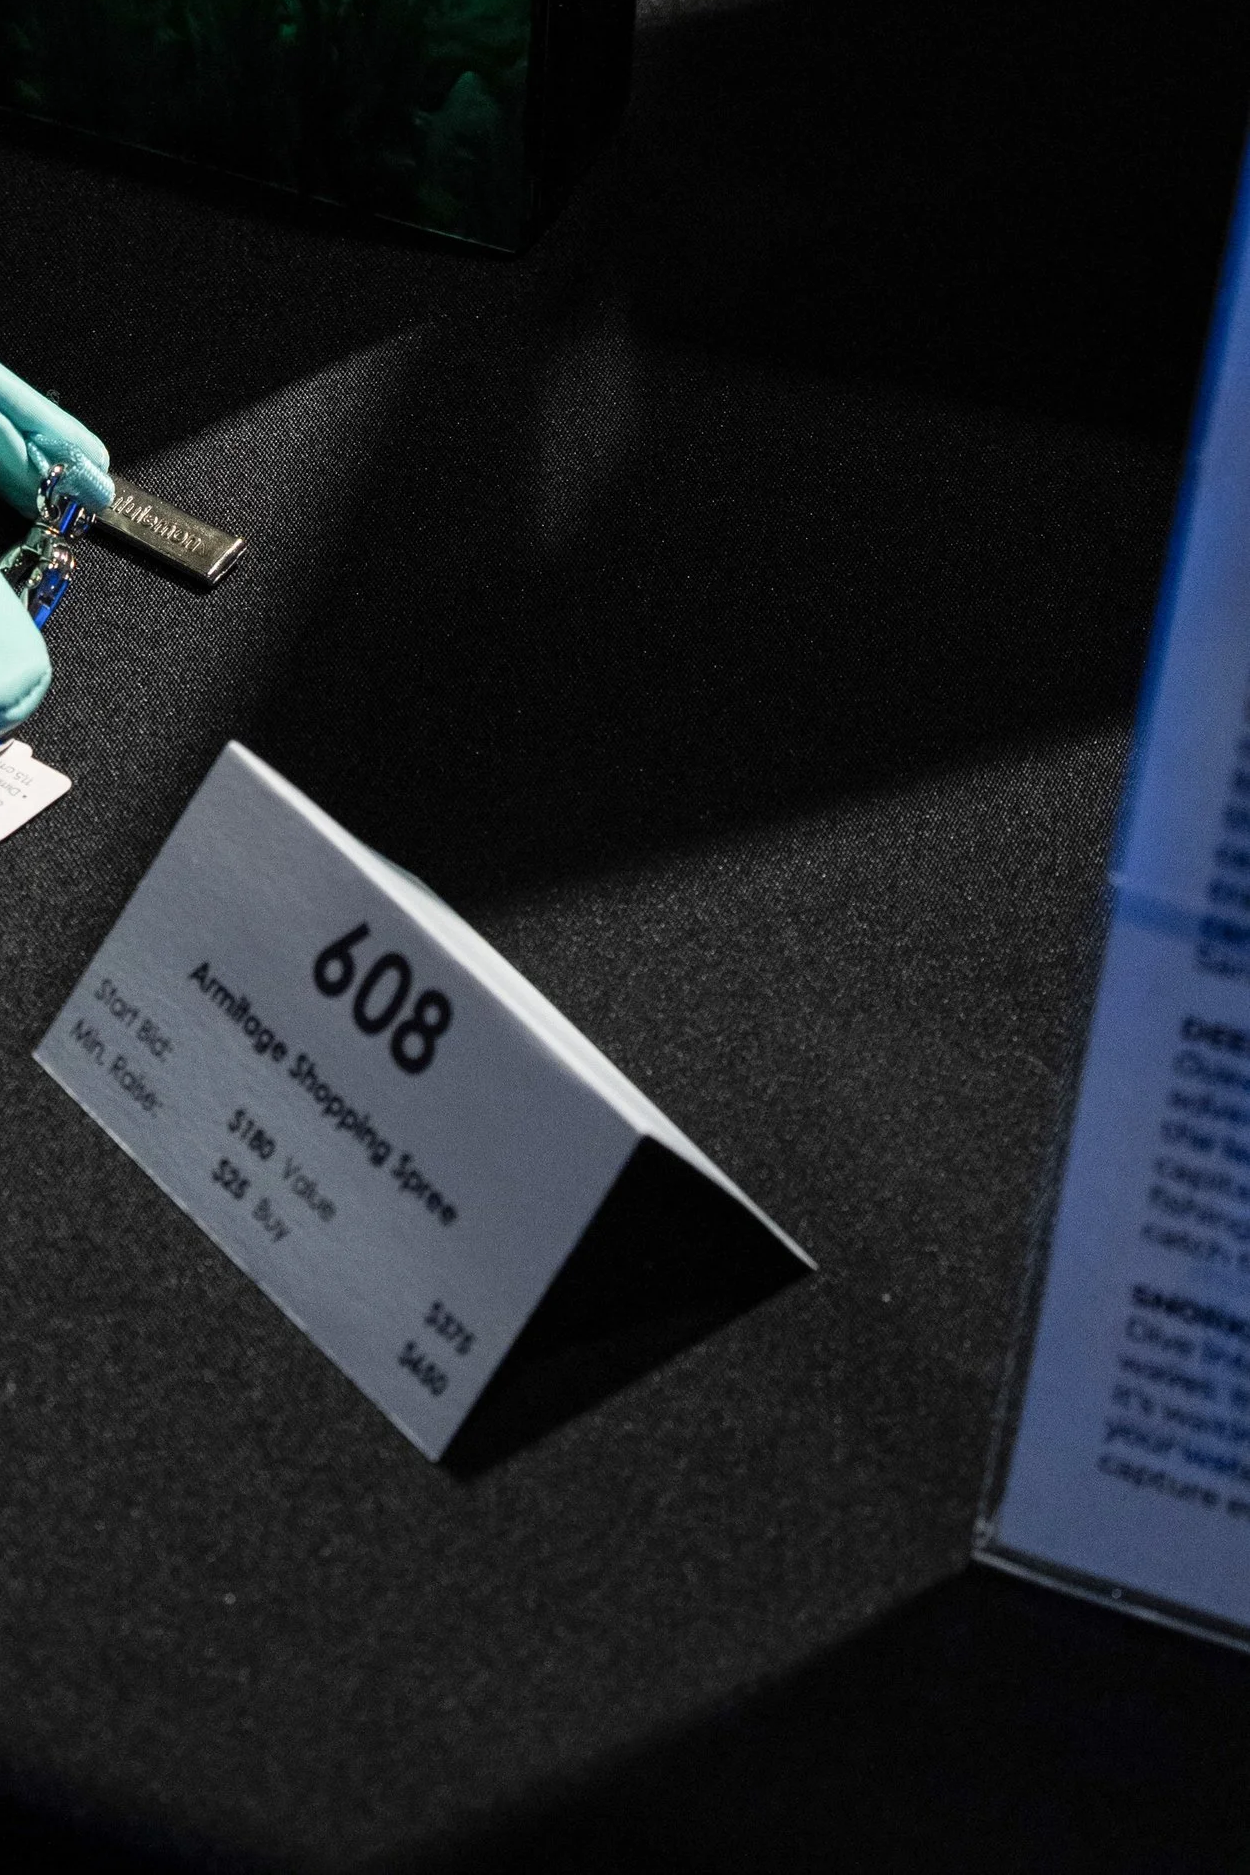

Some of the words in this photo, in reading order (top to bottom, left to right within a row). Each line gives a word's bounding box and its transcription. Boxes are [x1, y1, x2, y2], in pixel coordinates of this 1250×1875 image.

[93, 976, 141, 1027] Start
[280, 1154, 339, 1223] Value
[188, 960, 289, 1067] Armitage
[288, 1051, 395, 1169] Shopping
[390, 1152, 460, 1227] Spree
[312, 921, 453, 1077] 608
[209, 1156, 251, 1203] $25
[251, 1194, 292, 1243] Buy
